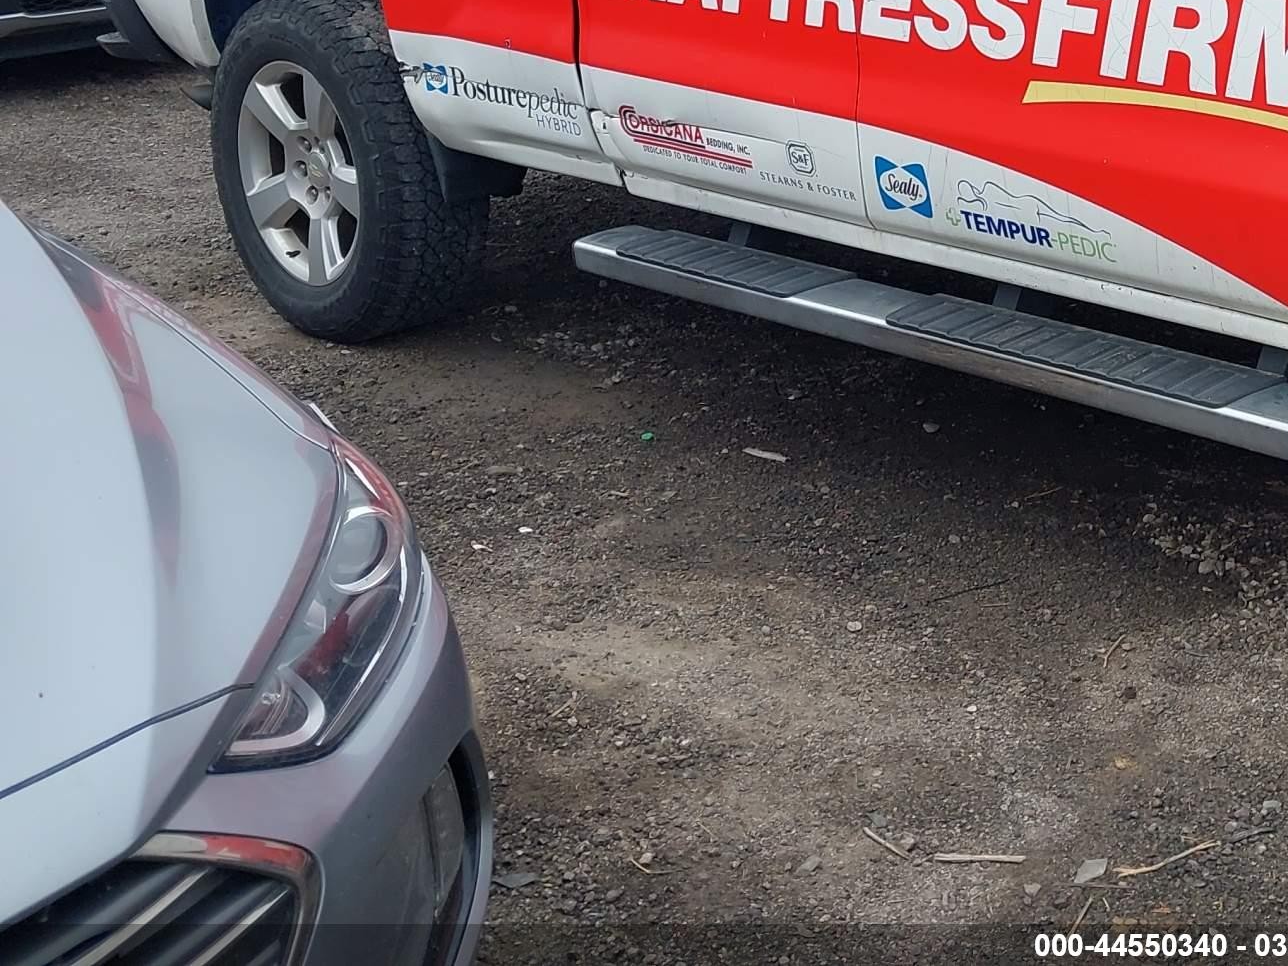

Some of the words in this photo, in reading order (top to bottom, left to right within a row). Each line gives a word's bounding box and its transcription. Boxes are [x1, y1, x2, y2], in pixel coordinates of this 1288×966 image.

[449, 66, 579, 119] Posturepedic
[536, 114, 582, 136] HYBRID
[618, 105, 705, 147] CORSICANA
[706, 137, 735, 153] BEDDING,
[737, 145, 751, 155] INC.
[791, 151, 809, 166] S&F
[760, 171, 804, 189] STEARNS
[807, 182, 814, 191] &
[817, 184, 857, 201] FOSTER
[884, 173, 921, 200] Sealy
[960, 210, 1116, 262] TEMPUR-PEDIC
